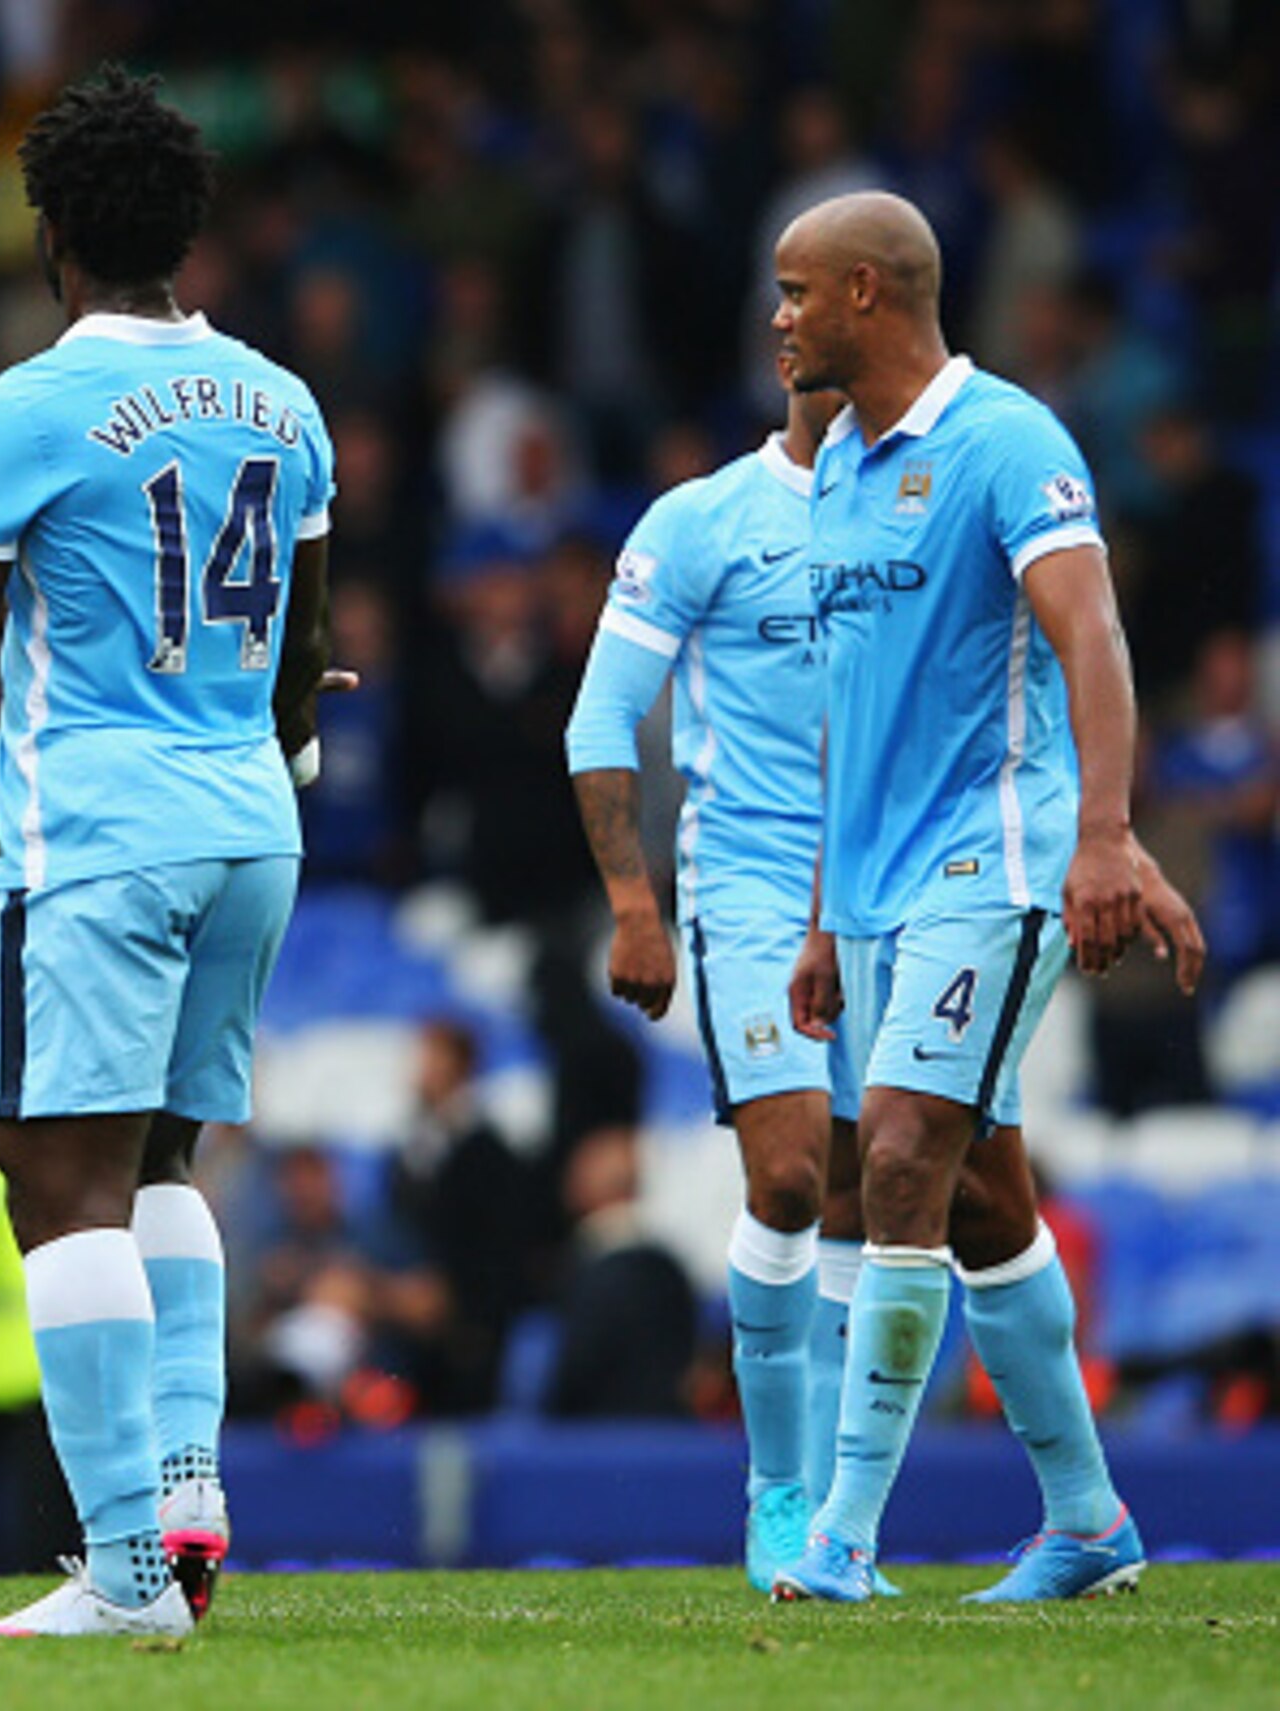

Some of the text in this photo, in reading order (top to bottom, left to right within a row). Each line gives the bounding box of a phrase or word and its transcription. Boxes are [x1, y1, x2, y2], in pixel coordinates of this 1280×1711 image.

[87, 374, 300, 457] WILFRIED
[141, 454, 281, 674] 14
[930, 965, 979, 1046] 4
